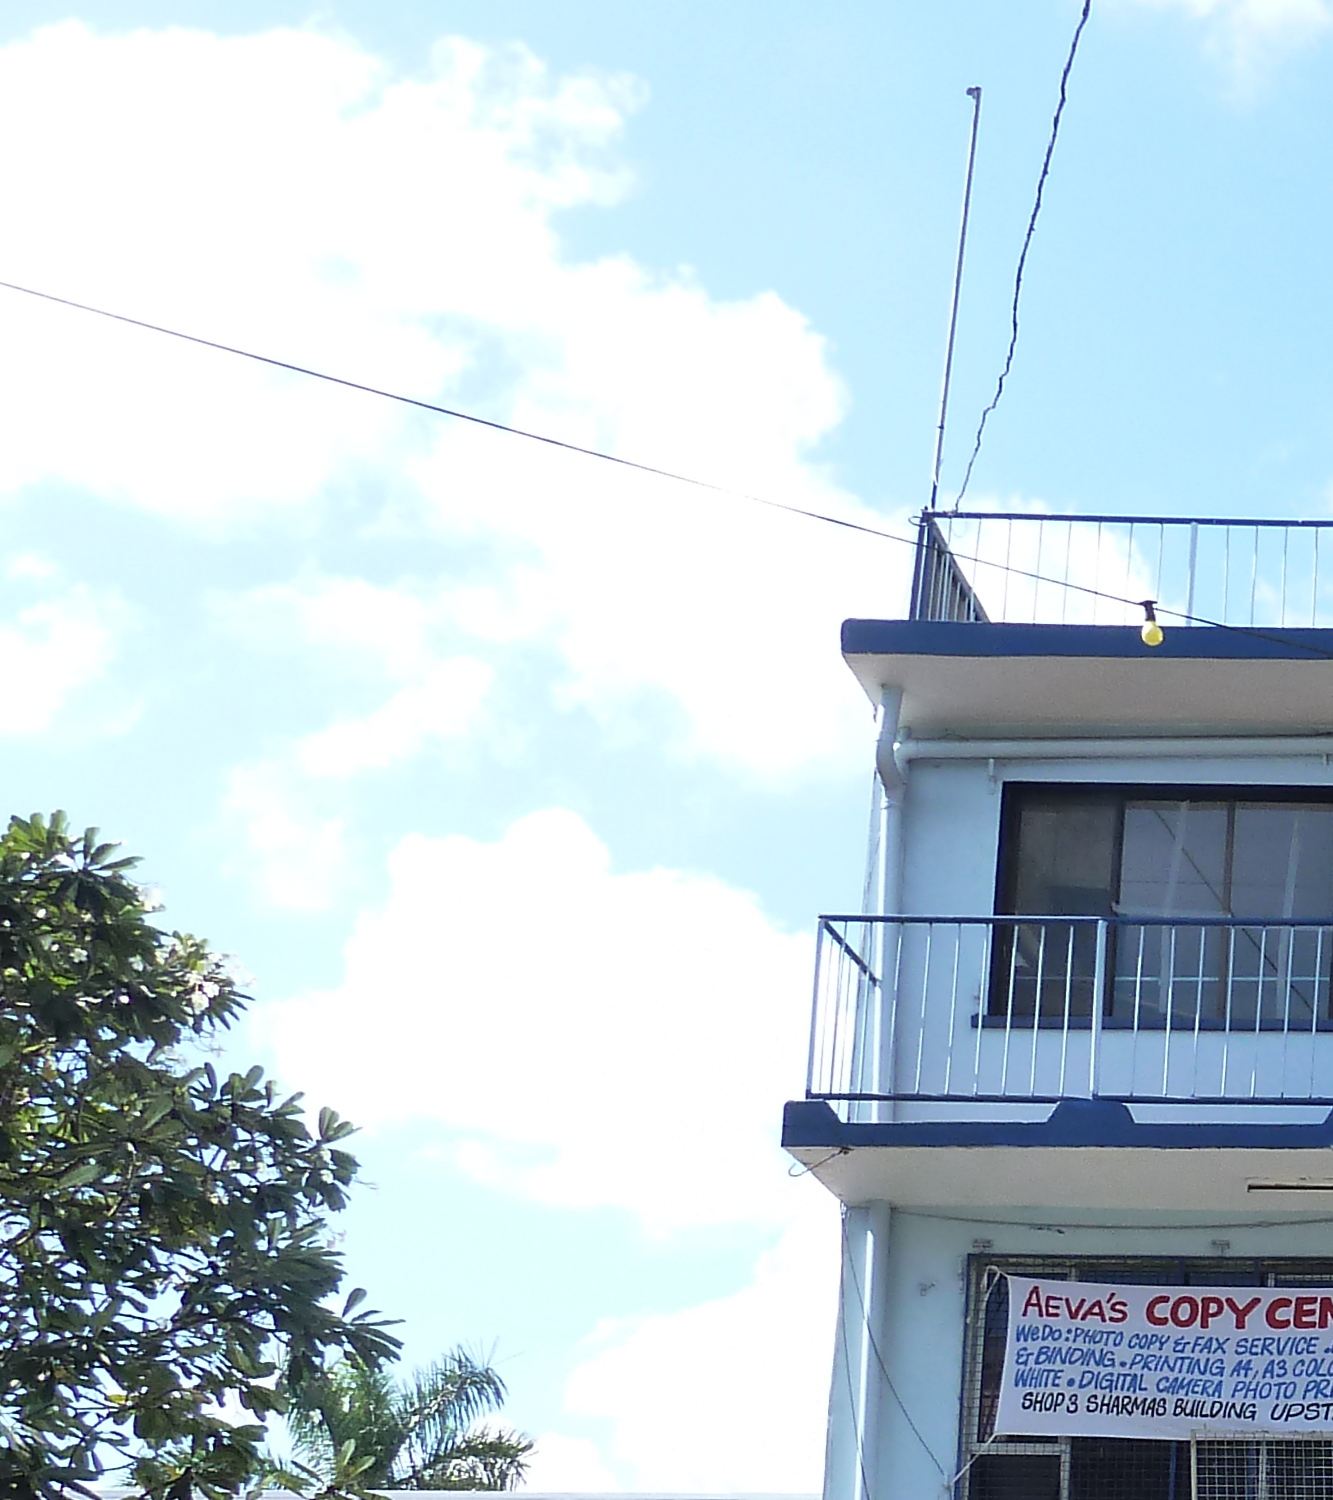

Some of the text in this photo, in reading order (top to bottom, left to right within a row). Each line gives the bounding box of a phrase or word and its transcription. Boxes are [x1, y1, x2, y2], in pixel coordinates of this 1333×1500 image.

[1022, 1287, 1128, 1324] AEVA'S
[1145, 1294, 1262, 1330] COPY
[1128, 1333, 1170, 1352] COPY
[1193, 1337, 1230, 1354] FAX
[1236, 1337, 1319, 1355] SERVICE
[1230, 1359, 1258, 1381] A4,
[1263, 1360, 1289, 1378] A3
[1081, 1370, 1148, 1394] DIGITAL
[1156, 1376, 1223, 1398] CAMERA
[1231, 1377, 1299, 1400] PHOTO
[1022, 1392, 1065, 1412] SHOP
[1066, 1395, 1078, 1414] 3
[1086, 1393, 1168, 1416] SHARMAS
[1172, 1397, 1257, 1420] BUILDING
